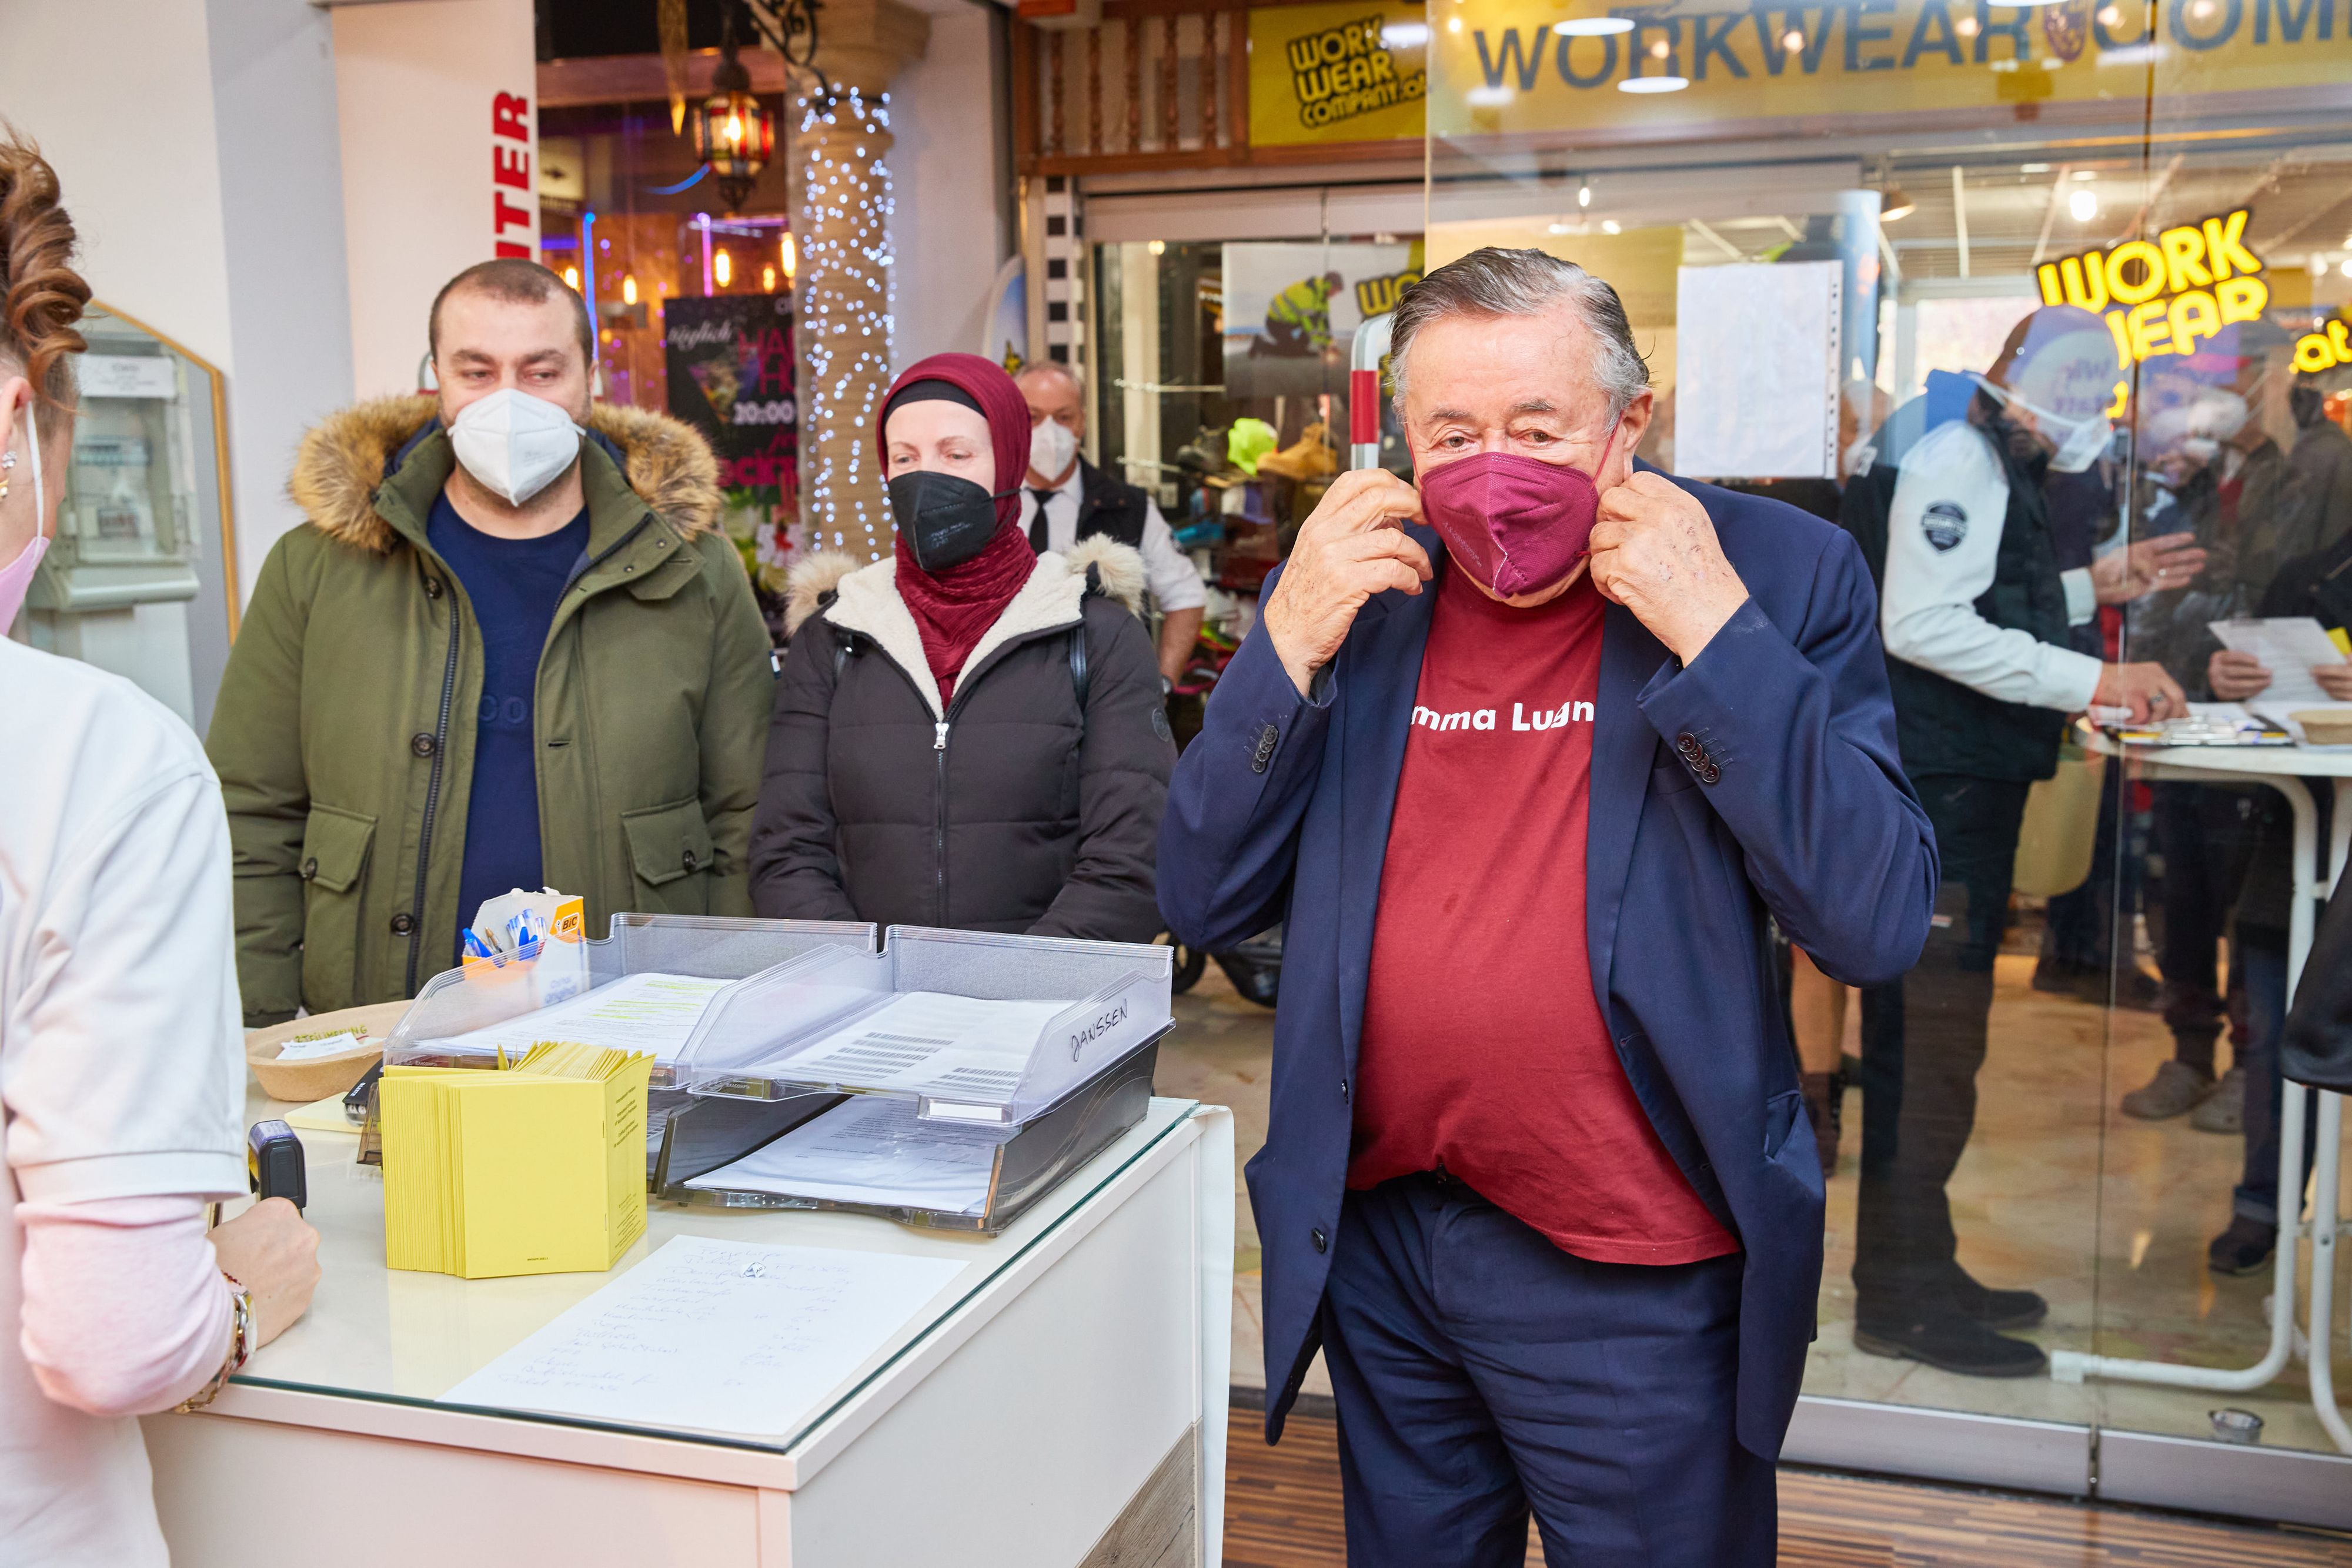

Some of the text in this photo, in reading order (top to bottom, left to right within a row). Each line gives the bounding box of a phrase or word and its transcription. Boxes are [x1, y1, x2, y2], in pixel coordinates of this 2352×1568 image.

[1290, 18, 1385, 71] WORK
[2092, 0, 2352, 52] COM
[1296, 51, 1394, 103] WEAR
[2038, 210, 2263, 314] WORK
[1071, 998, 1128, 1062] JANSSEN
